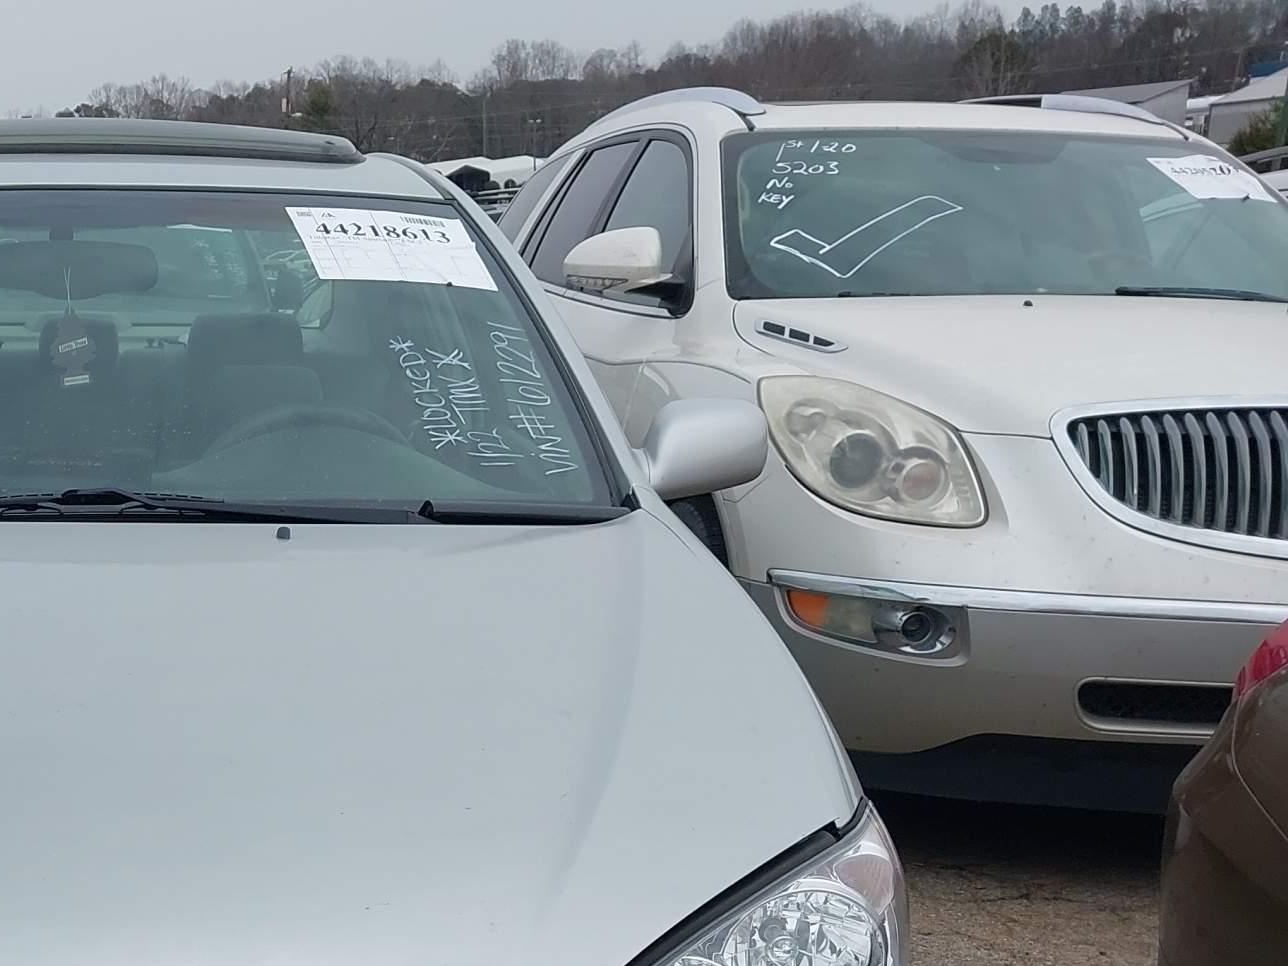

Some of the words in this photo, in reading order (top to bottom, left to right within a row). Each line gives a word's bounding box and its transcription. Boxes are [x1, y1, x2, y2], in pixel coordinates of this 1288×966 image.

[810, 139, 857, 153] 1-20
[772, 160, 840, 175] 5203
[315, 222, 451, 244] 44218613
